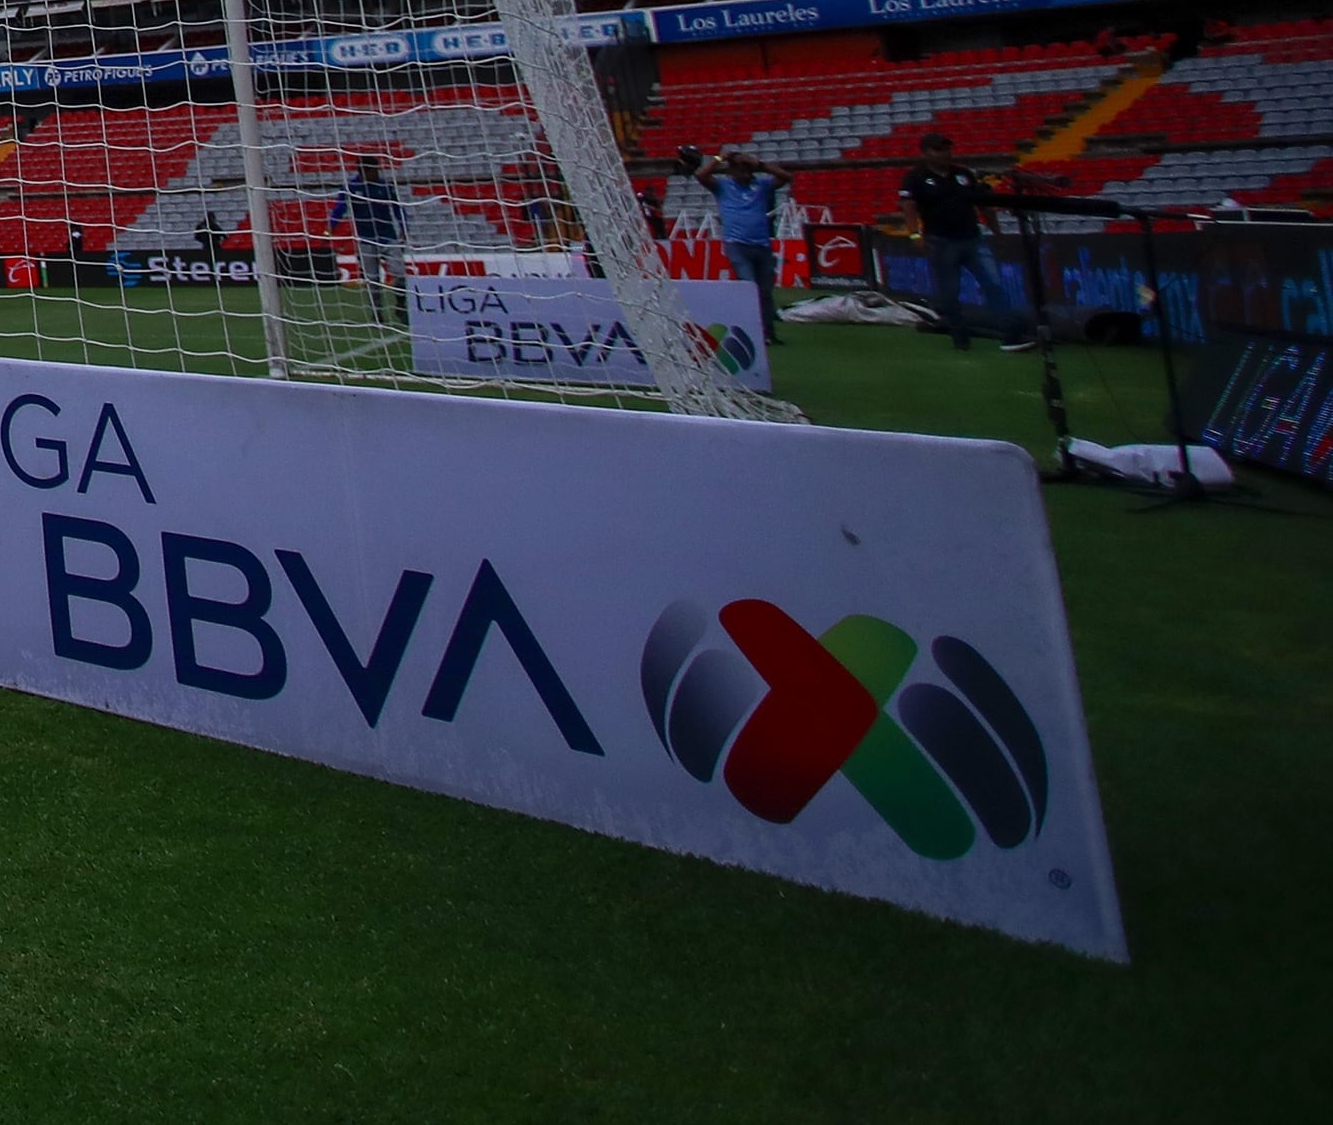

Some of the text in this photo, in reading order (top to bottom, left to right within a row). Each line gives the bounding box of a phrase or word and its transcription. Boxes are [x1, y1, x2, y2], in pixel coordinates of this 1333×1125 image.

[675, 13, 717, 33] Los
[723, 3, 820, 28] Laureles
[413, 285, 508, 315] LIGA
[464, 320, 648, 367] BBVA
[42, 512, 605, 757] BBVA
